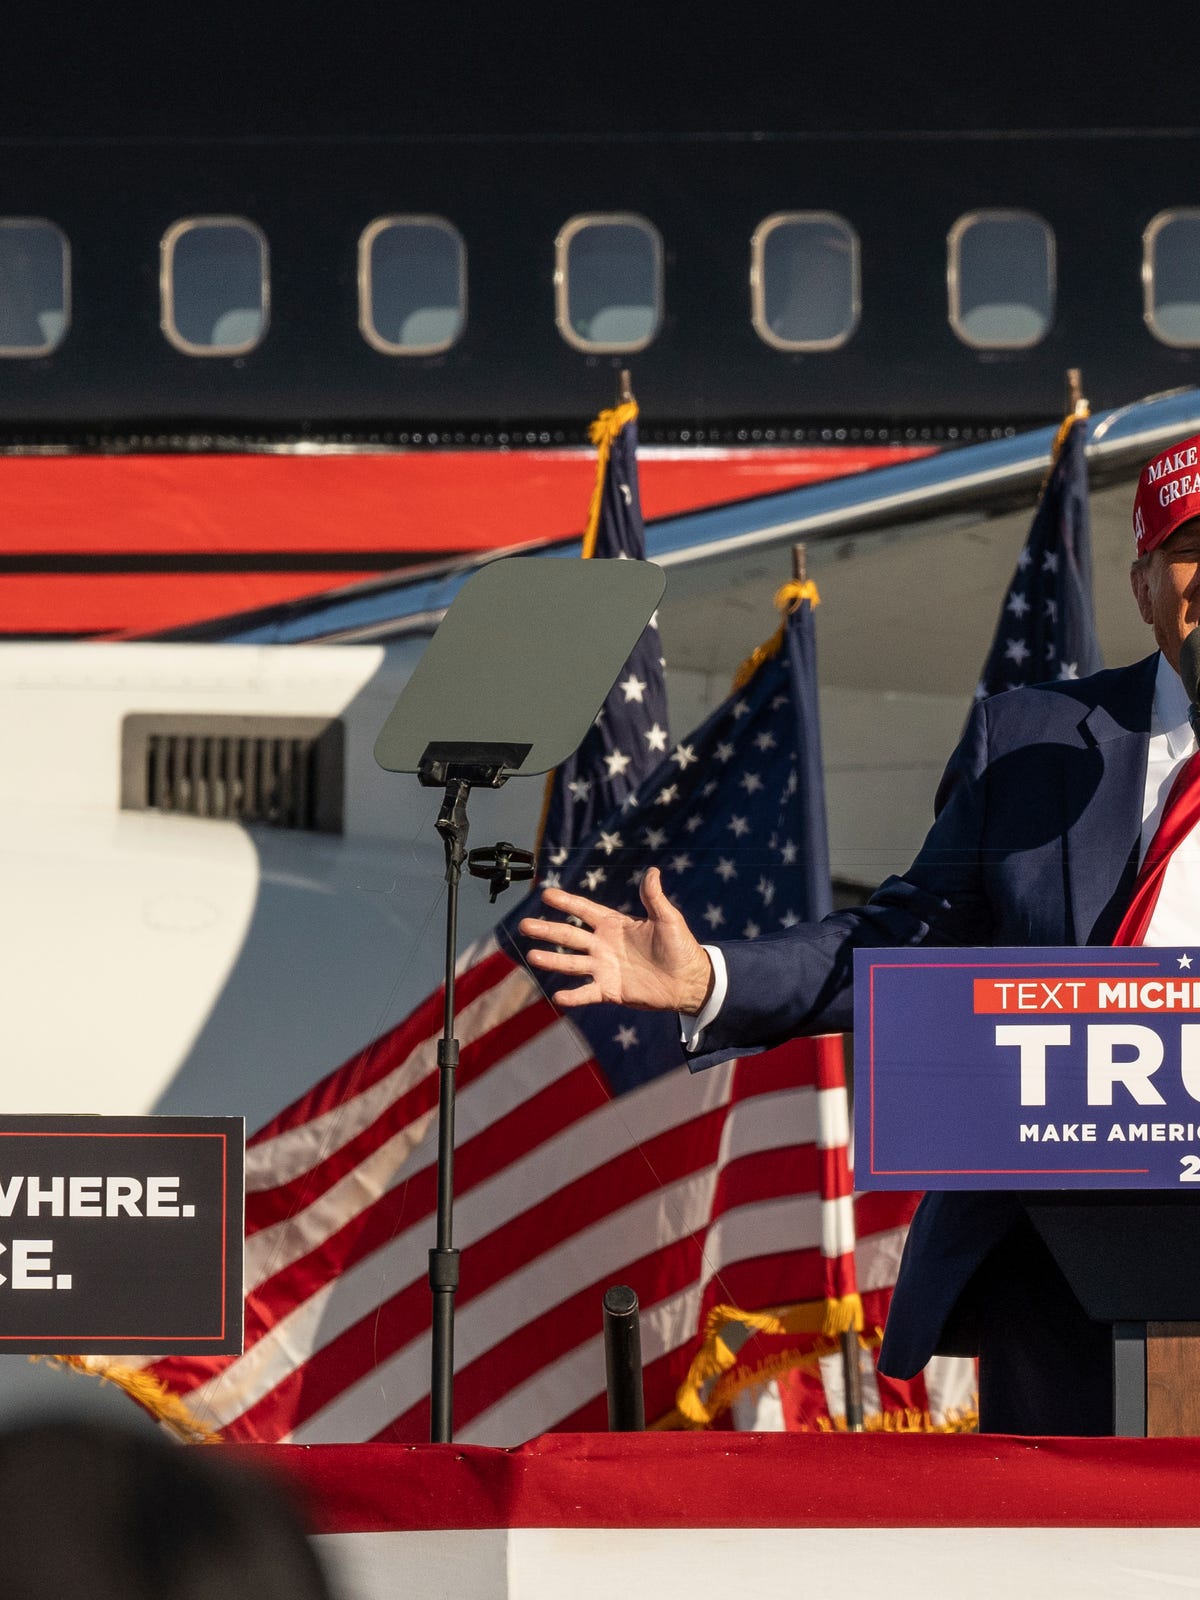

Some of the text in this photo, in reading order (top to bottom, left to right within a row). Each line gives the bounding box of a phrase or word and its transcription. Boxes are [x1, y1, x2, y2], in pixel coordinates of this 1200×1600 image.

[1147, 447, 1198, 484] MAKE
[994, 982, 1086, 1009] TEXT
[1020, 1123, 1097, 1142] MAKE
[0, 1239, 72, 1290] E.
